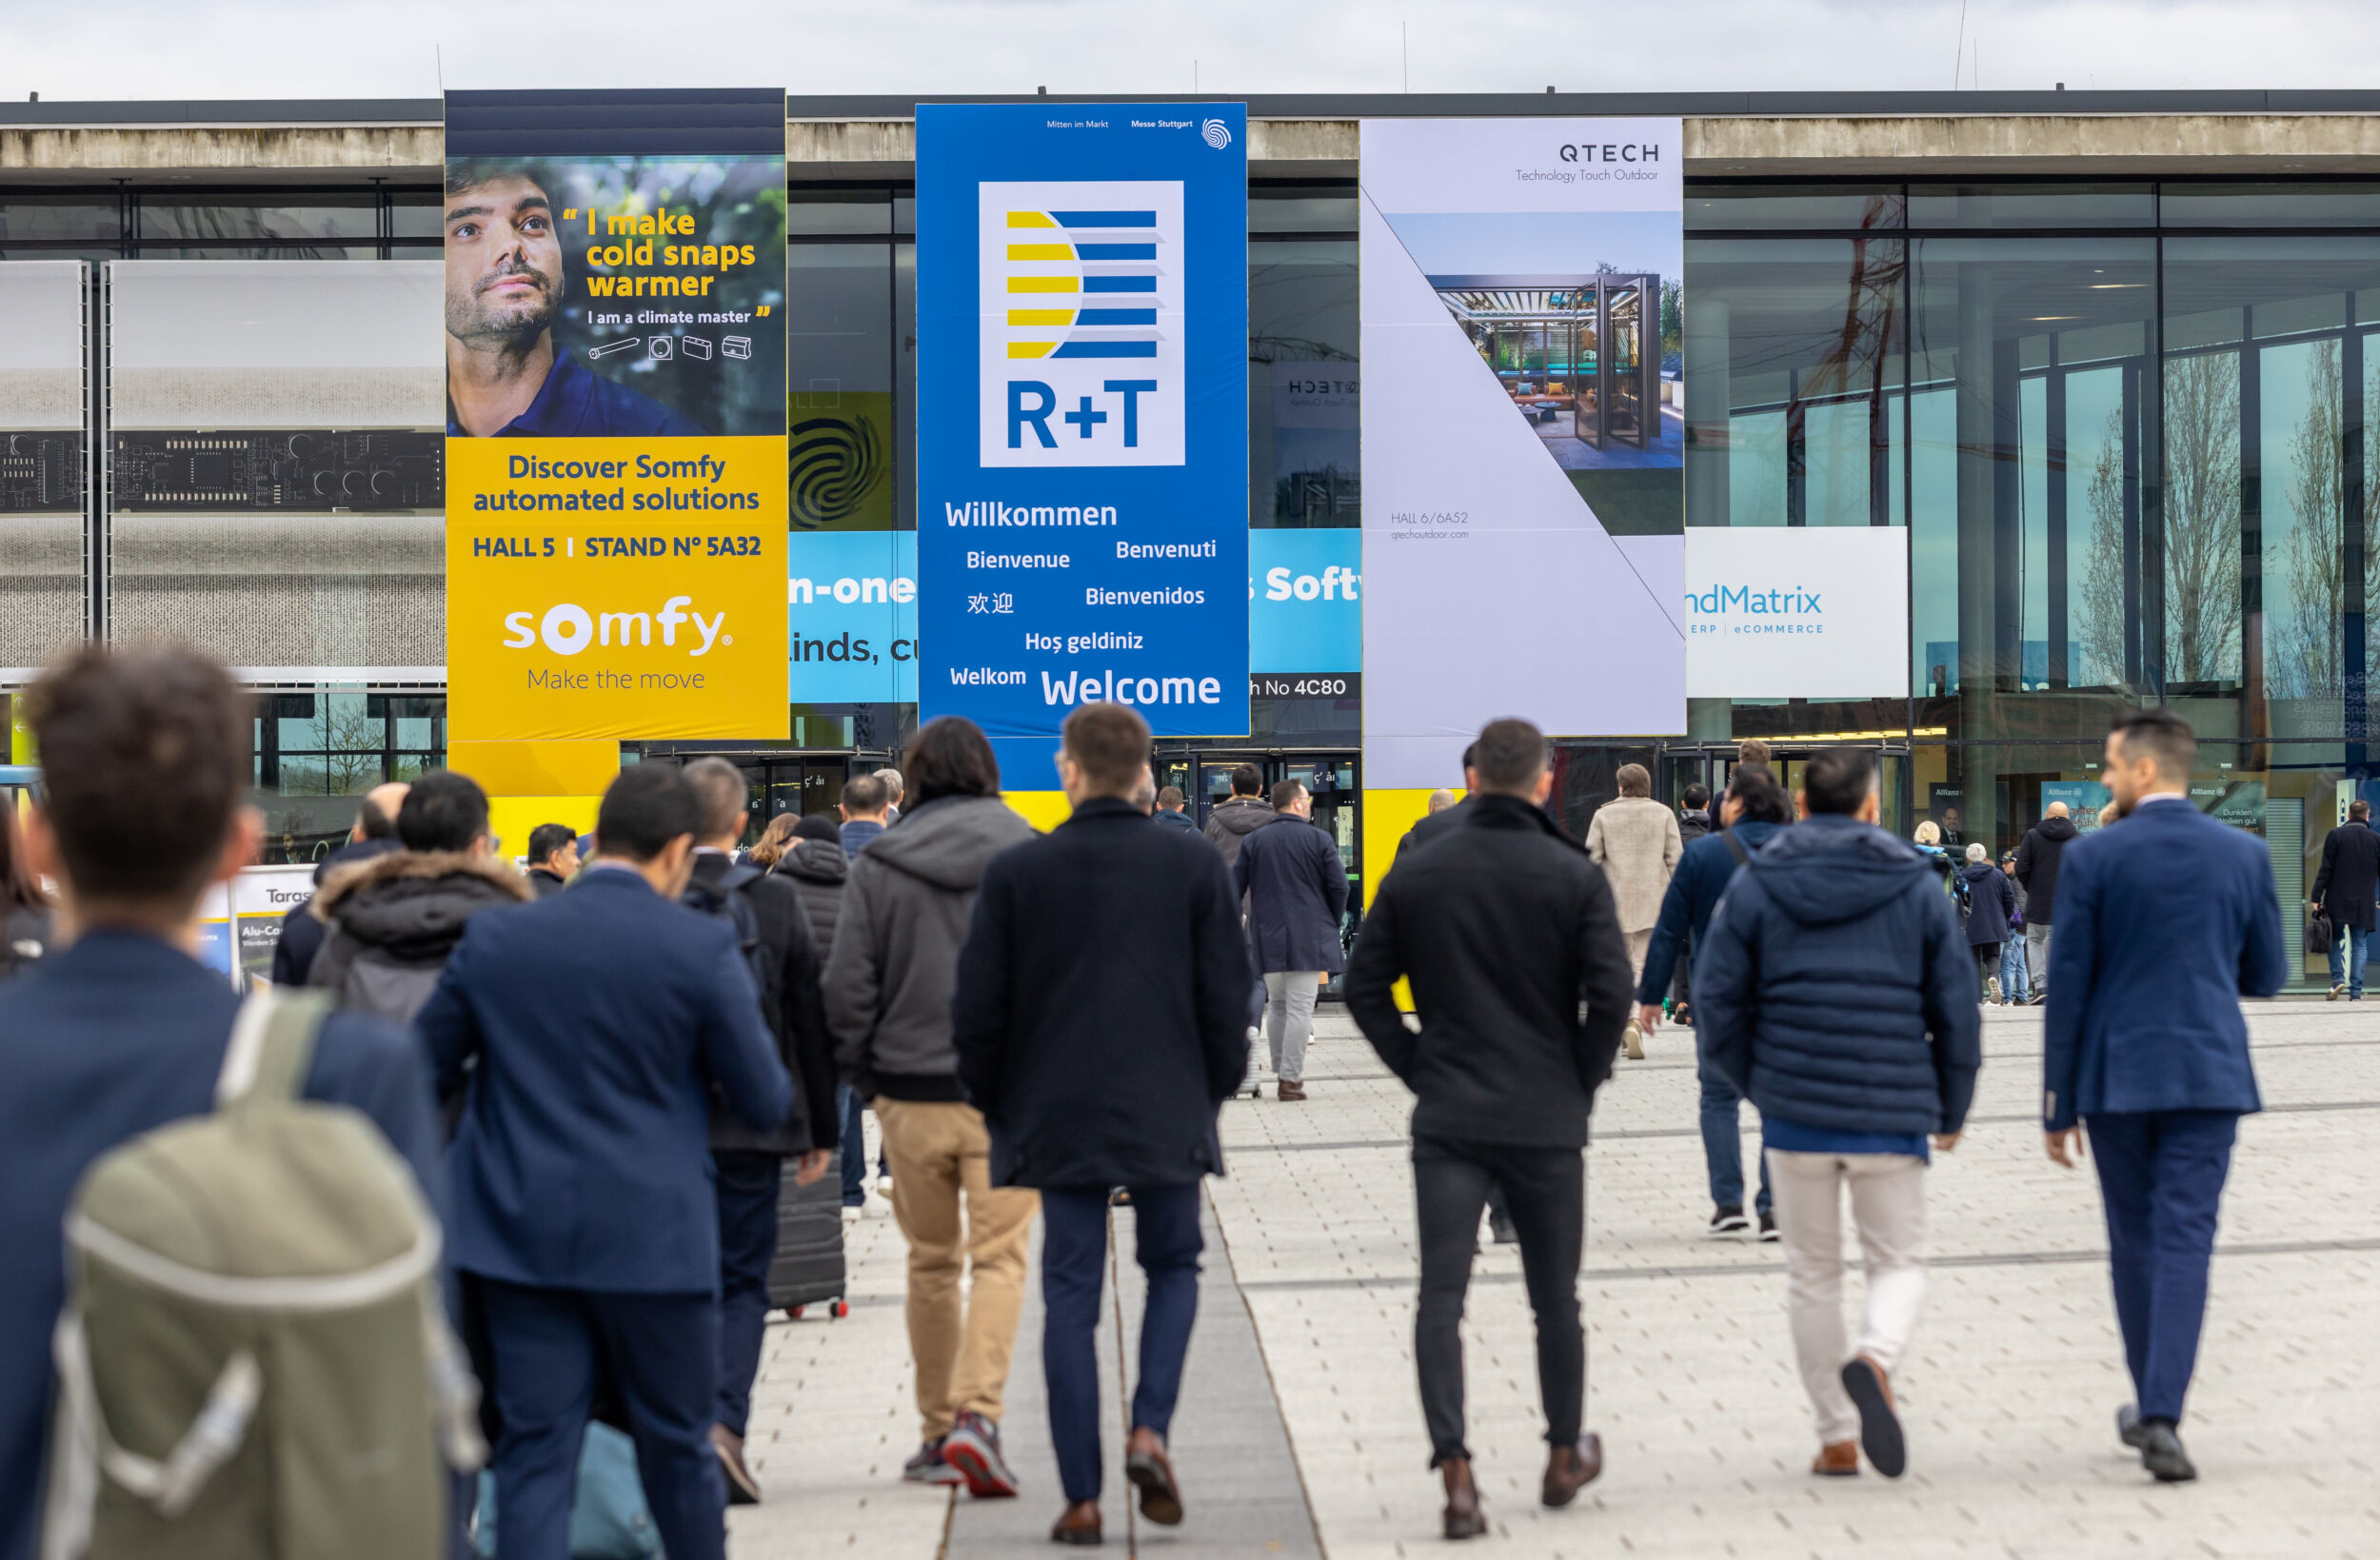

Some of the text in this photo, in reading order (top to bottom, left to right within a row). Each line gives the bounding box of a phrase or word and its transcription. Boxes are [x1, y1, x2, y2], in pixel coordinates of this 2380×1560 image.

[1046, 120, 1109, 128] Mitten im Markt
[1131, 120, 1193, 128] Messe Stuttgart
[1559, 144, 1659, 163] QTECH
[1516, 168, 1658, 184] Technology Touch Outdoor
[607, 207, 695, 236] make
[586, 238, 756, 271] cold snaps
[586, 275, 715, 297] warmer
[587, 310, 592, 324] I
[597, 311, 621, 324] am
[625, 312, 633, 324] a
[638, 309, 693, 324] climate
[697, 310, 751, 324] master
[1007, 380, 1158, 449] R+T
[508, 454, 725, 484] Discover Somfy
[473, 486, 760, 511] automated solutions
[945, 502, 1118, 526] Willkommen
[1391, 512, 1468, 524] HALL 6/6A52
[1391, 528, 1469, 541] qtechoutdoor.com
[473, 538, 537, 557] HALL
[543, 538, 555, 557] 5
[585, 537, 666, 557] STAND
[706, 536, 762, 556] 5A32
[1117, 540, 1217, 558] Benvenuti
[966, 551, 1070, 568] Bienvenue
[1265, 565, 1361, 601] Soft
[966, 593, 1014, 614] 欢迎
[1086, 587, 1205, 604] Bienvenidos
[1691, 624, 1823, 634] ERP eCOMMERCE
[789, 632, 879, 665] inds,
[1025, 632, 1143, 654] Hoş geldiniz
[527, 669, 705, 689] Make the move
[950, 667, 1026, 685] Welkom
[1041, 670, 1220, 705] Welcome
[1266, 680, 1290, 696] No
[1295, 679, 1346, 695] 4C80
